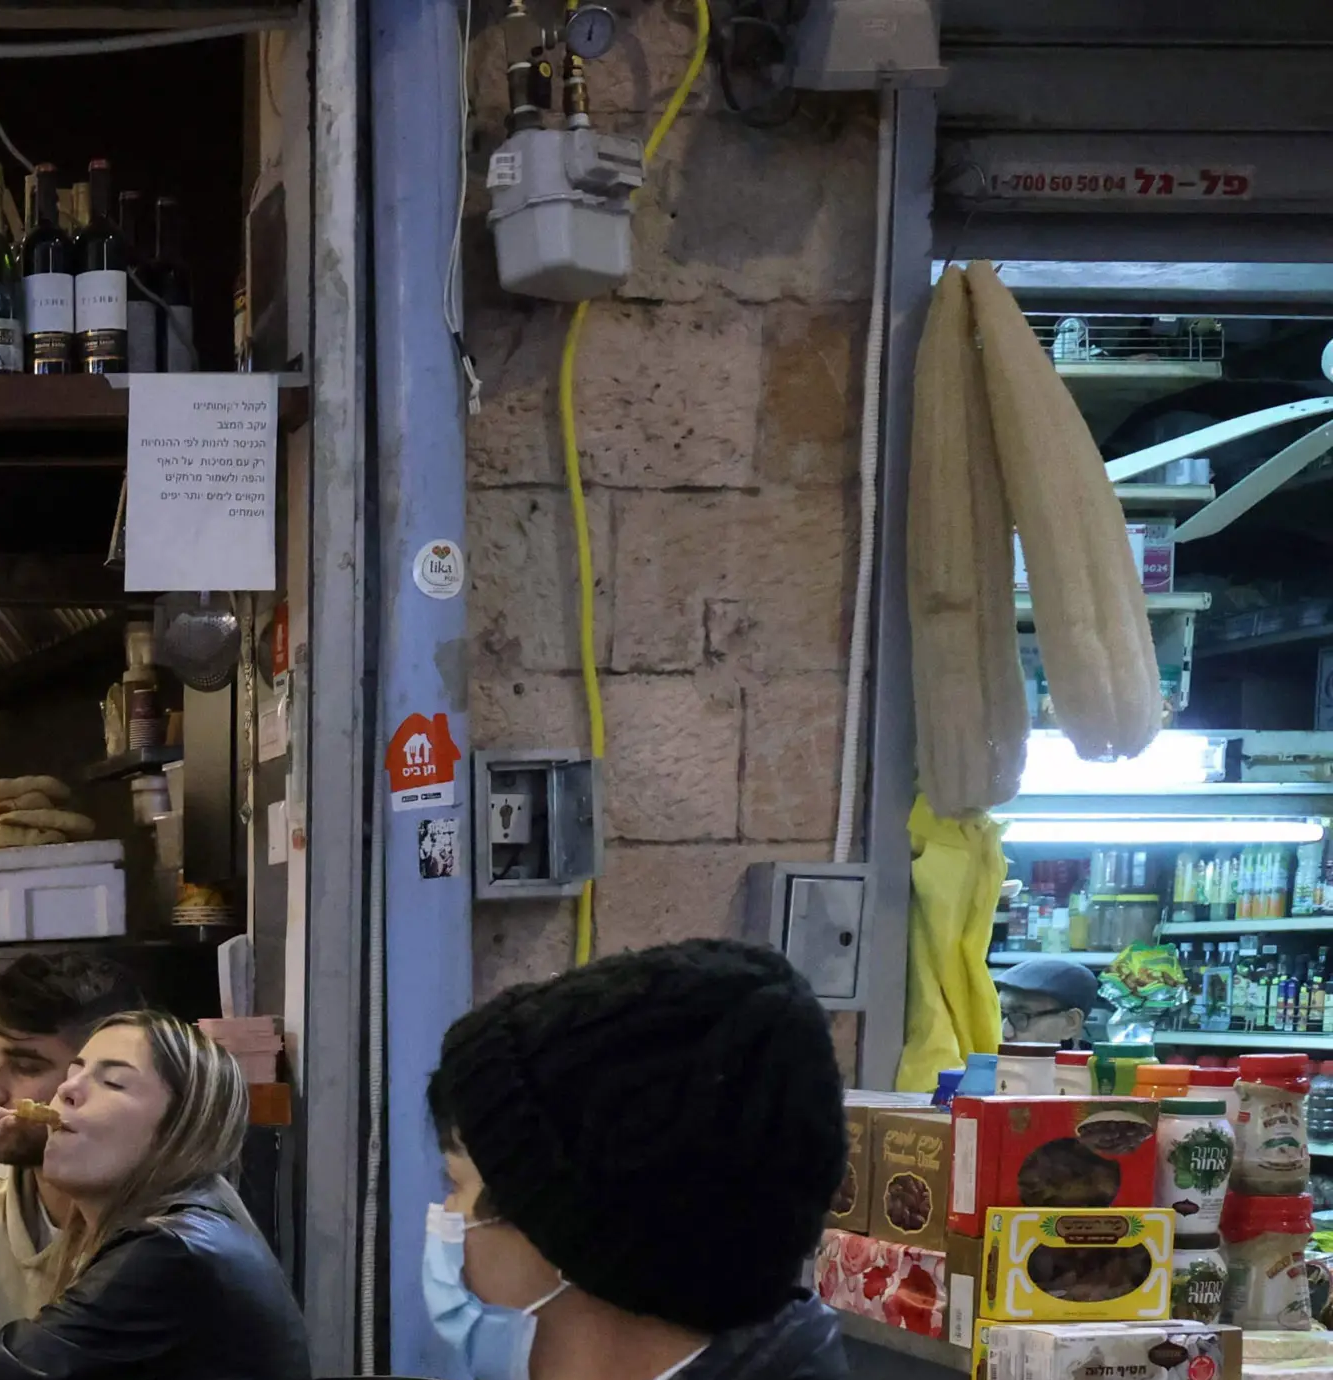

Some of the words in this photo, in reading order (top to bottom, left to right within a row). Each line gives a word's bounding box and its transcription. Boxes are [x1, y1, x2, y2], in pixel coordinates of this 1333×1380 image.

[242, 401, 267, 412] לקהל
[217, 421, 243, 429] המצב
[246, 421, 267, 431] עקב
[233, 439, 266, 448] הכניסה
[157, 457, 179, 468] האף
[182, 456, 194, 466] על
[200, 457, 233, 466] מסיכות
[236, 458, 249, 466] עם
[253, 458, 265, 469] רק
[206, 472, 238, 483] ולשמור
[241, 475, 265, 483] והפה
[160, 492, 180, 500] יפים
[207, 491, 232, 500] לימים
[235, 493, 265, 502] מקווים
[228, 508, 265, 517] ושמחים
[430, 560, 452, 573] lika
[402, 766, 421, 777] ביס
[424, 764, 437, 777] תן
[1191, 1145, 1229, 1158] טחינה
[1191, 1157, 1227, 1171] אחוה
[1189, 1280, 1223, 1293] טחינה
[1188, 1291, 1222, 1303] אחוה
[1117, 1365, 1147, 1378] חטיף
